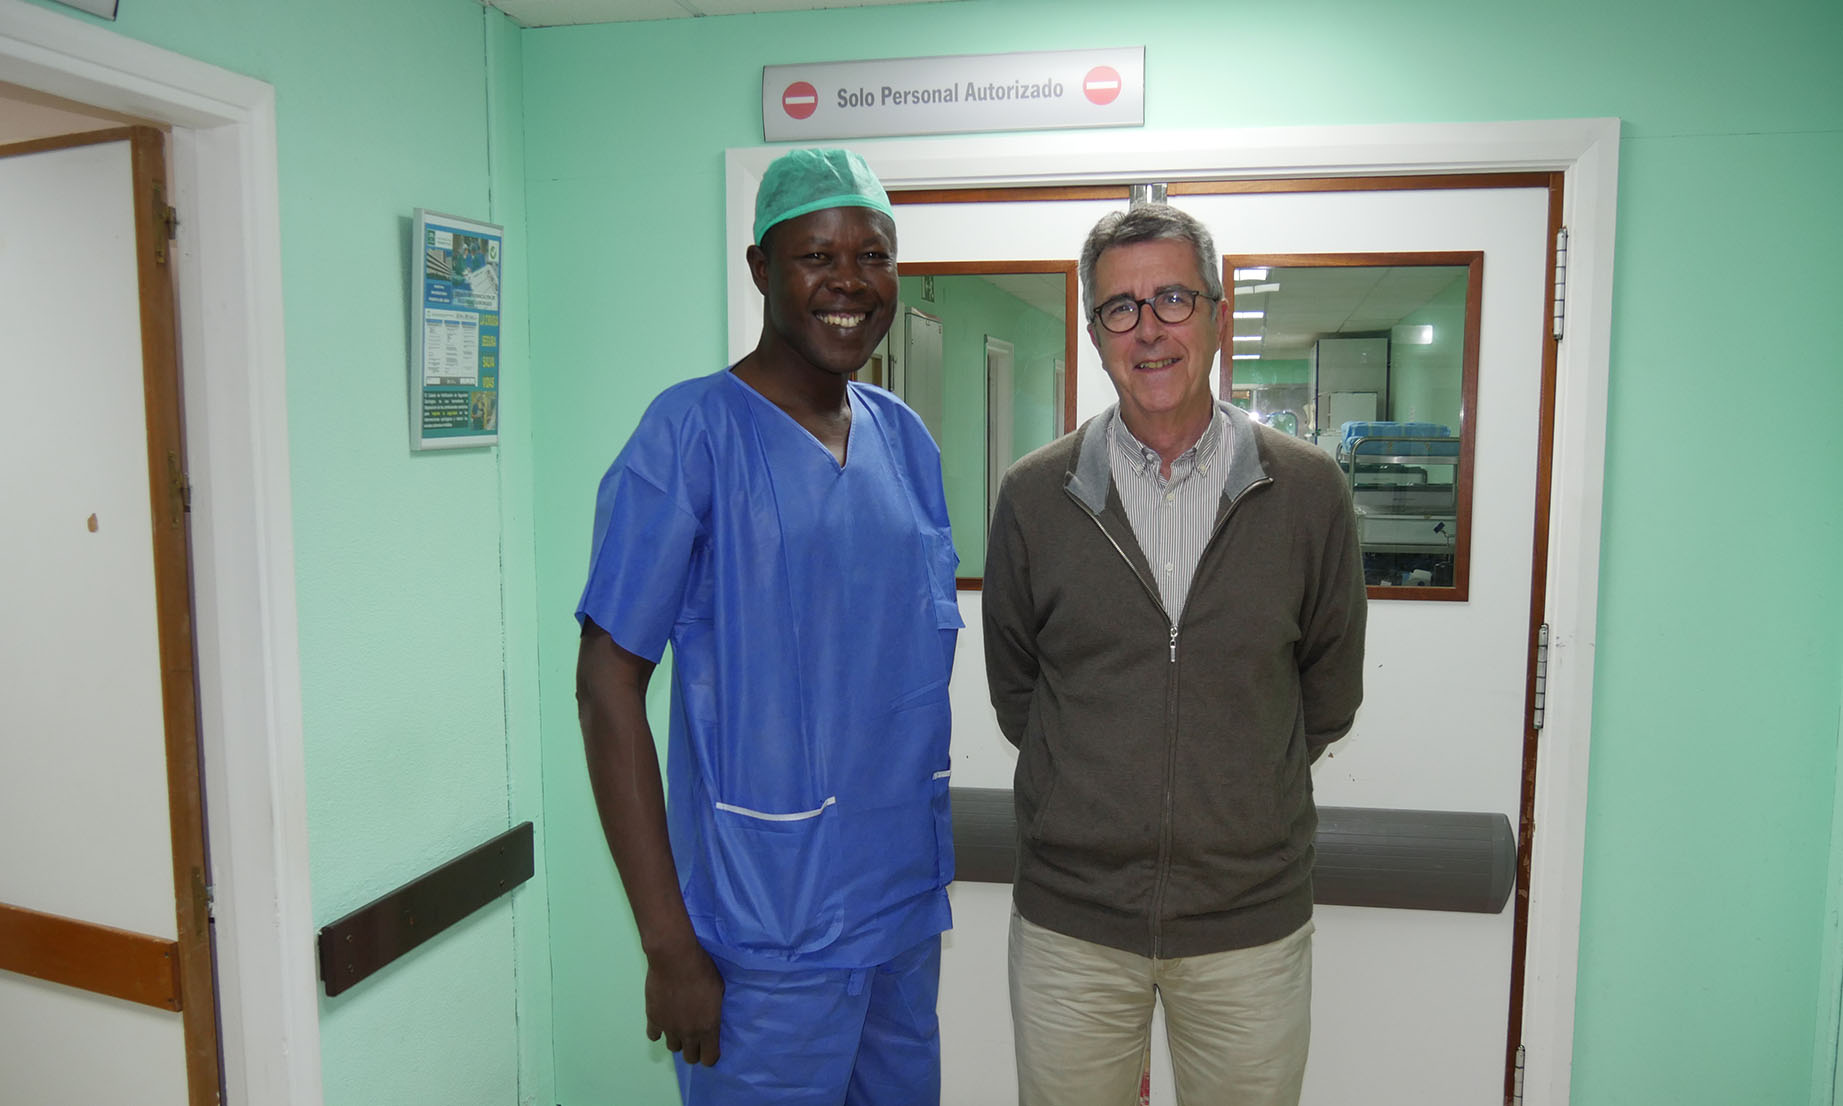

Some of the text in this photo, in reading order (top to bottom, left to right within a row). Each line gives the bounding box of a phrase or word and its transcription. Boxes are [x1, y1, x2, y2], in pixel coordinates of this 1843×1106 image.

[837, 78, 1064, 109] Solo Personal Autorizado
